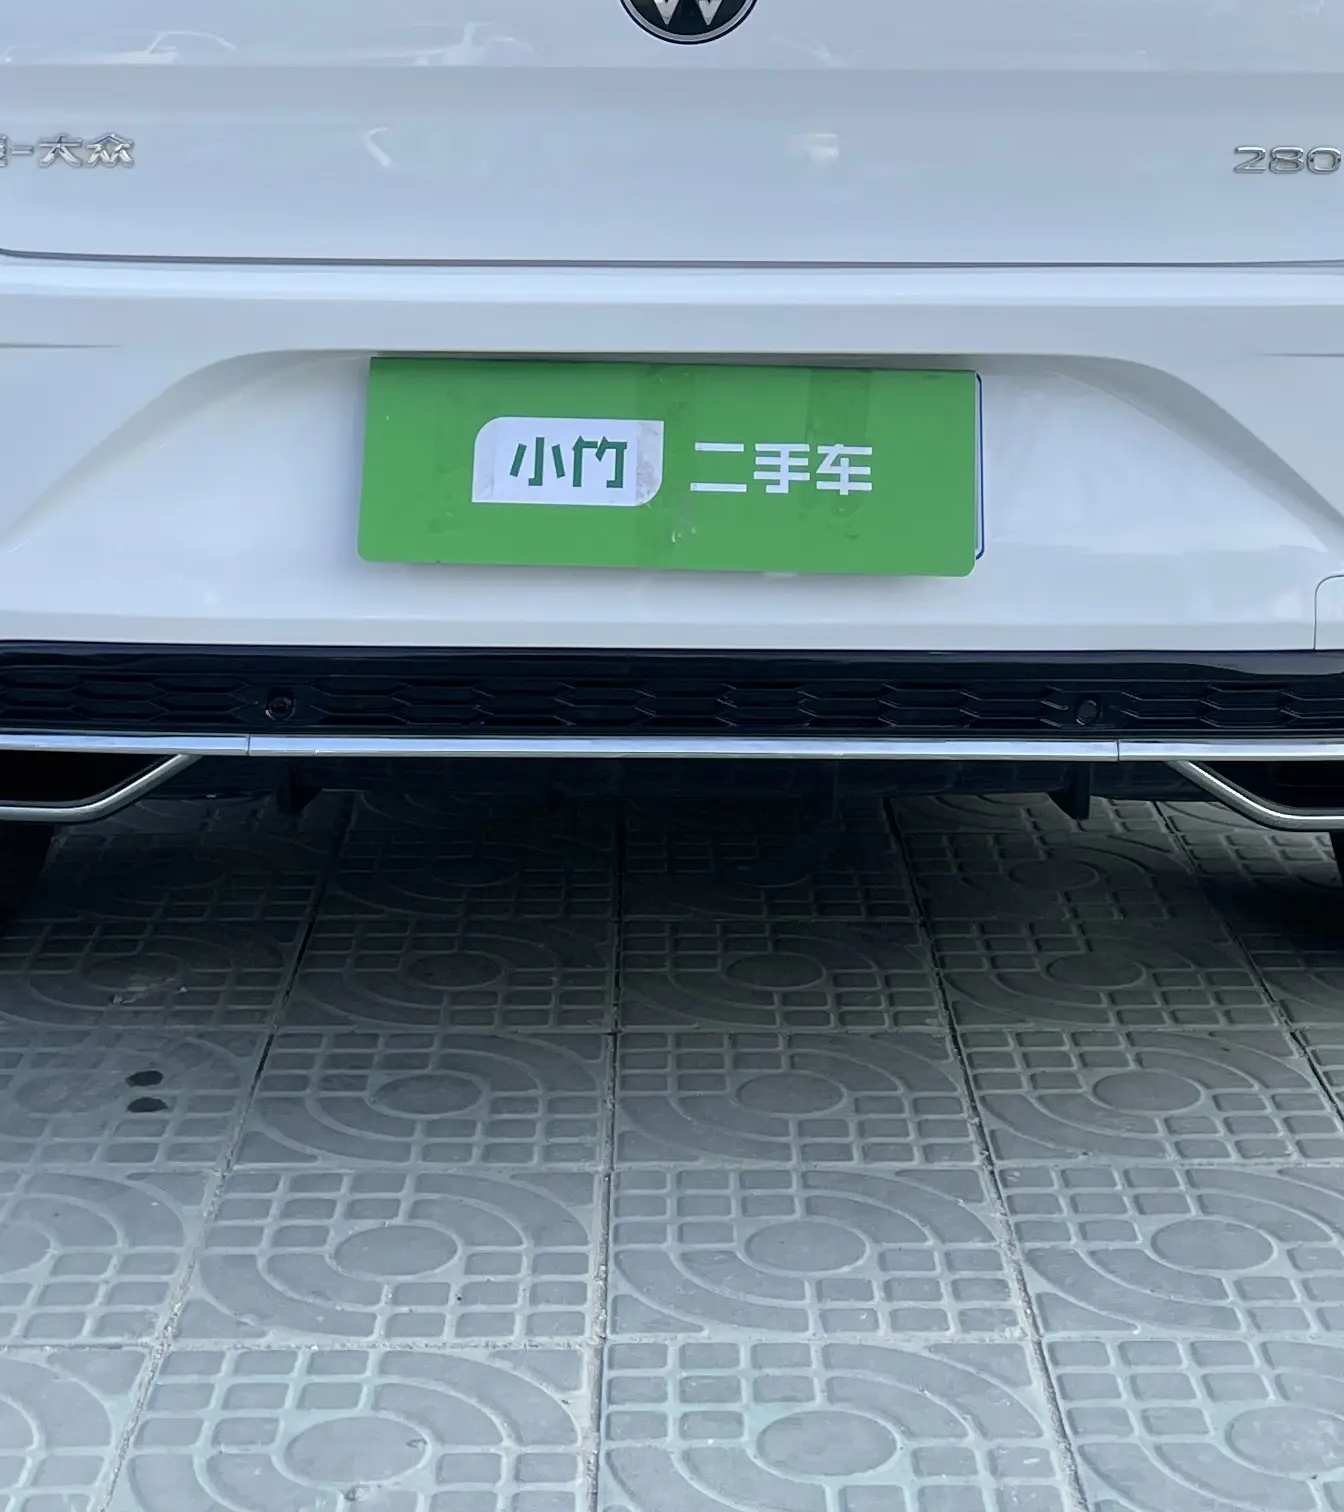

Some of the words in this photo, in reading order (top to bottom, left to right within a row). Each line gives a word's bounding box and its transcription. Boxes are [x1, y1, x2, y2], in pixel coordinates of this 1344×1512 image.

[1232, 145, 1342, 175] 280
[509, 435, 628, 489] 小竹
[689, 441, 873, 496] 二手车
